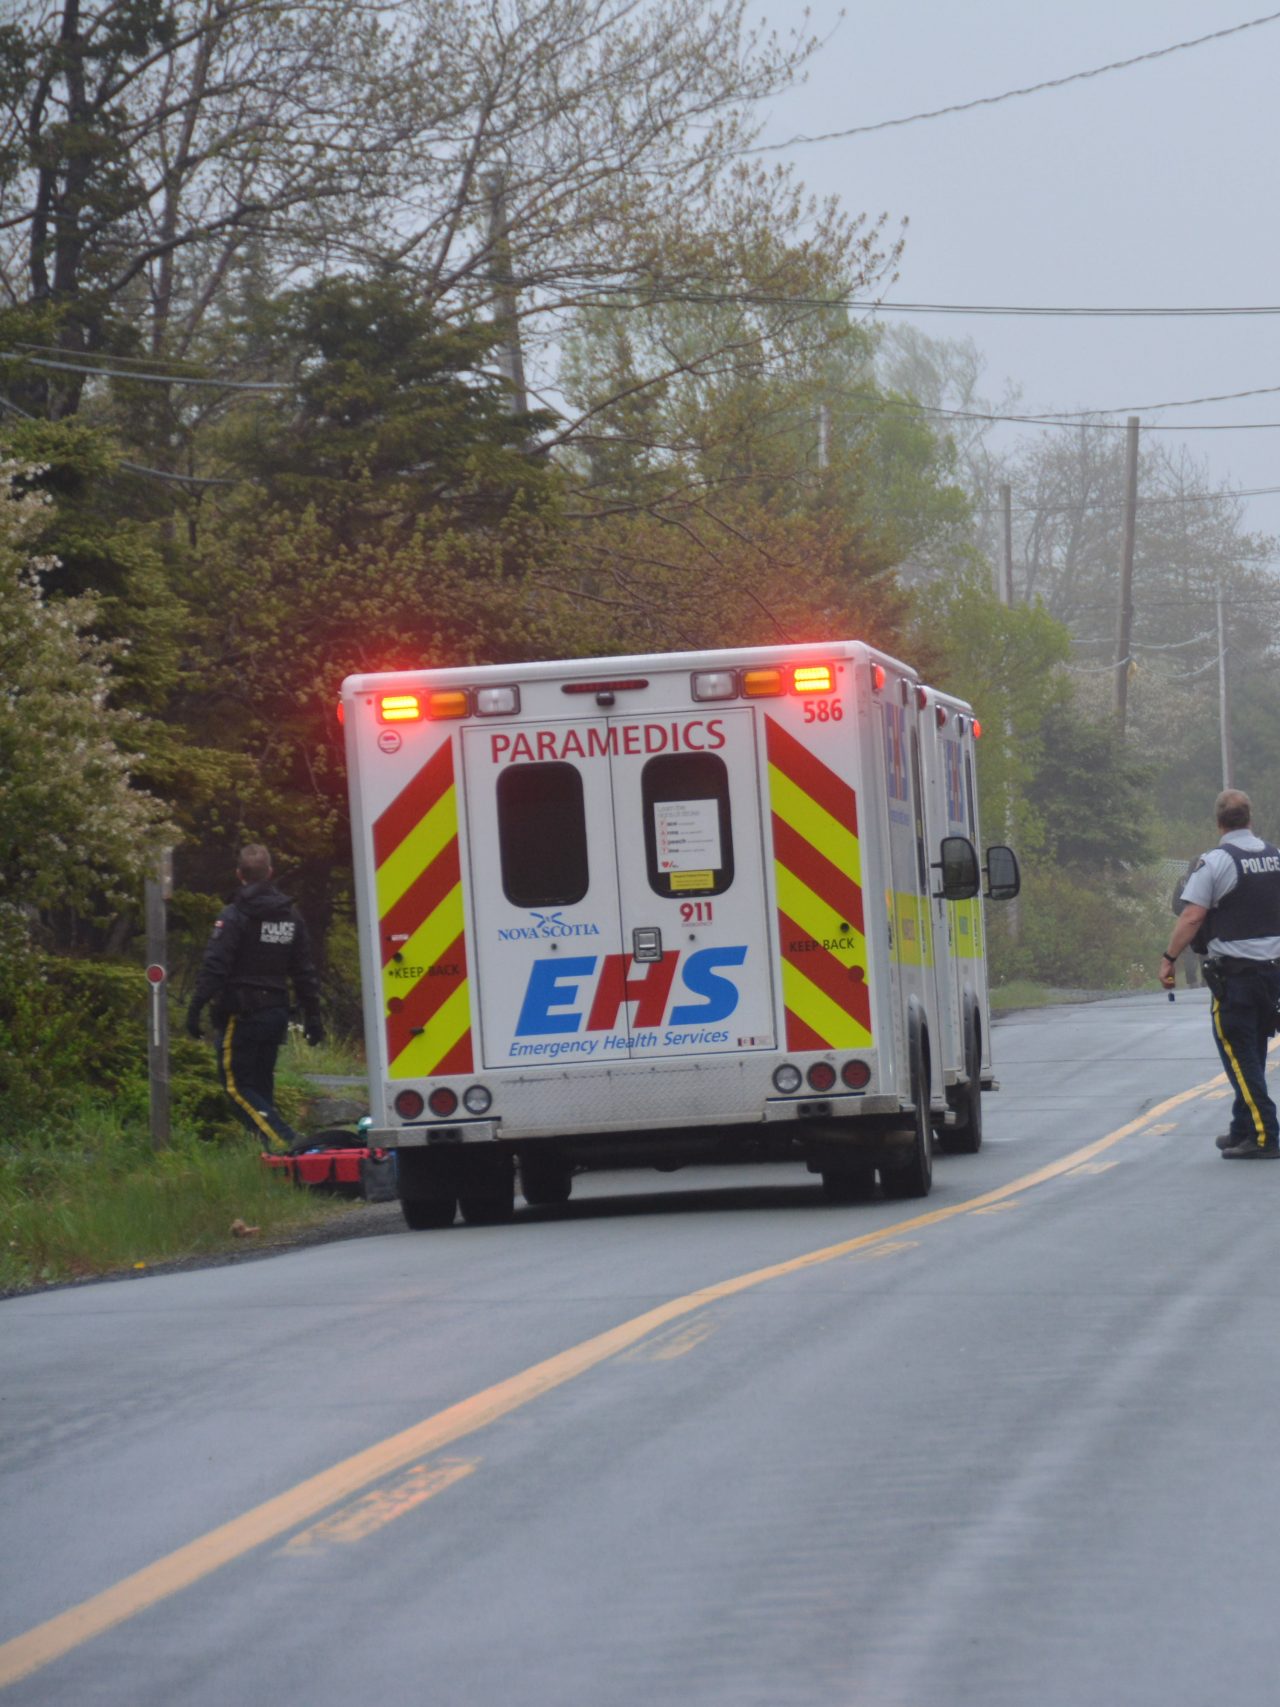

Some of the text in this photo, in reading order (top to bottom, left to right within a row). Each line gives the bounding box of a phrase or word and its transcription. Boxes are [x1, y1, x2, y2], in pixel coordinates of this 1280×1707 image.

[803, 699, 843, 723] 586
[490, 719, 726, 763] PARAMEDICS
[1241, 856, 1280, 874] POLICE
[680, 902, 712, 922] 911
[261, 921, 295, 936] POLICE
[498, 923, 600, 941] NOVA SCOTIA
[790, 938, 854, 952] KEEP BACK
[395, 964, 459, 978] KEEP BACK
[514, 945, 748, 1037] EHS
[509, 1029, 729, 1057] Emergency Health Services
